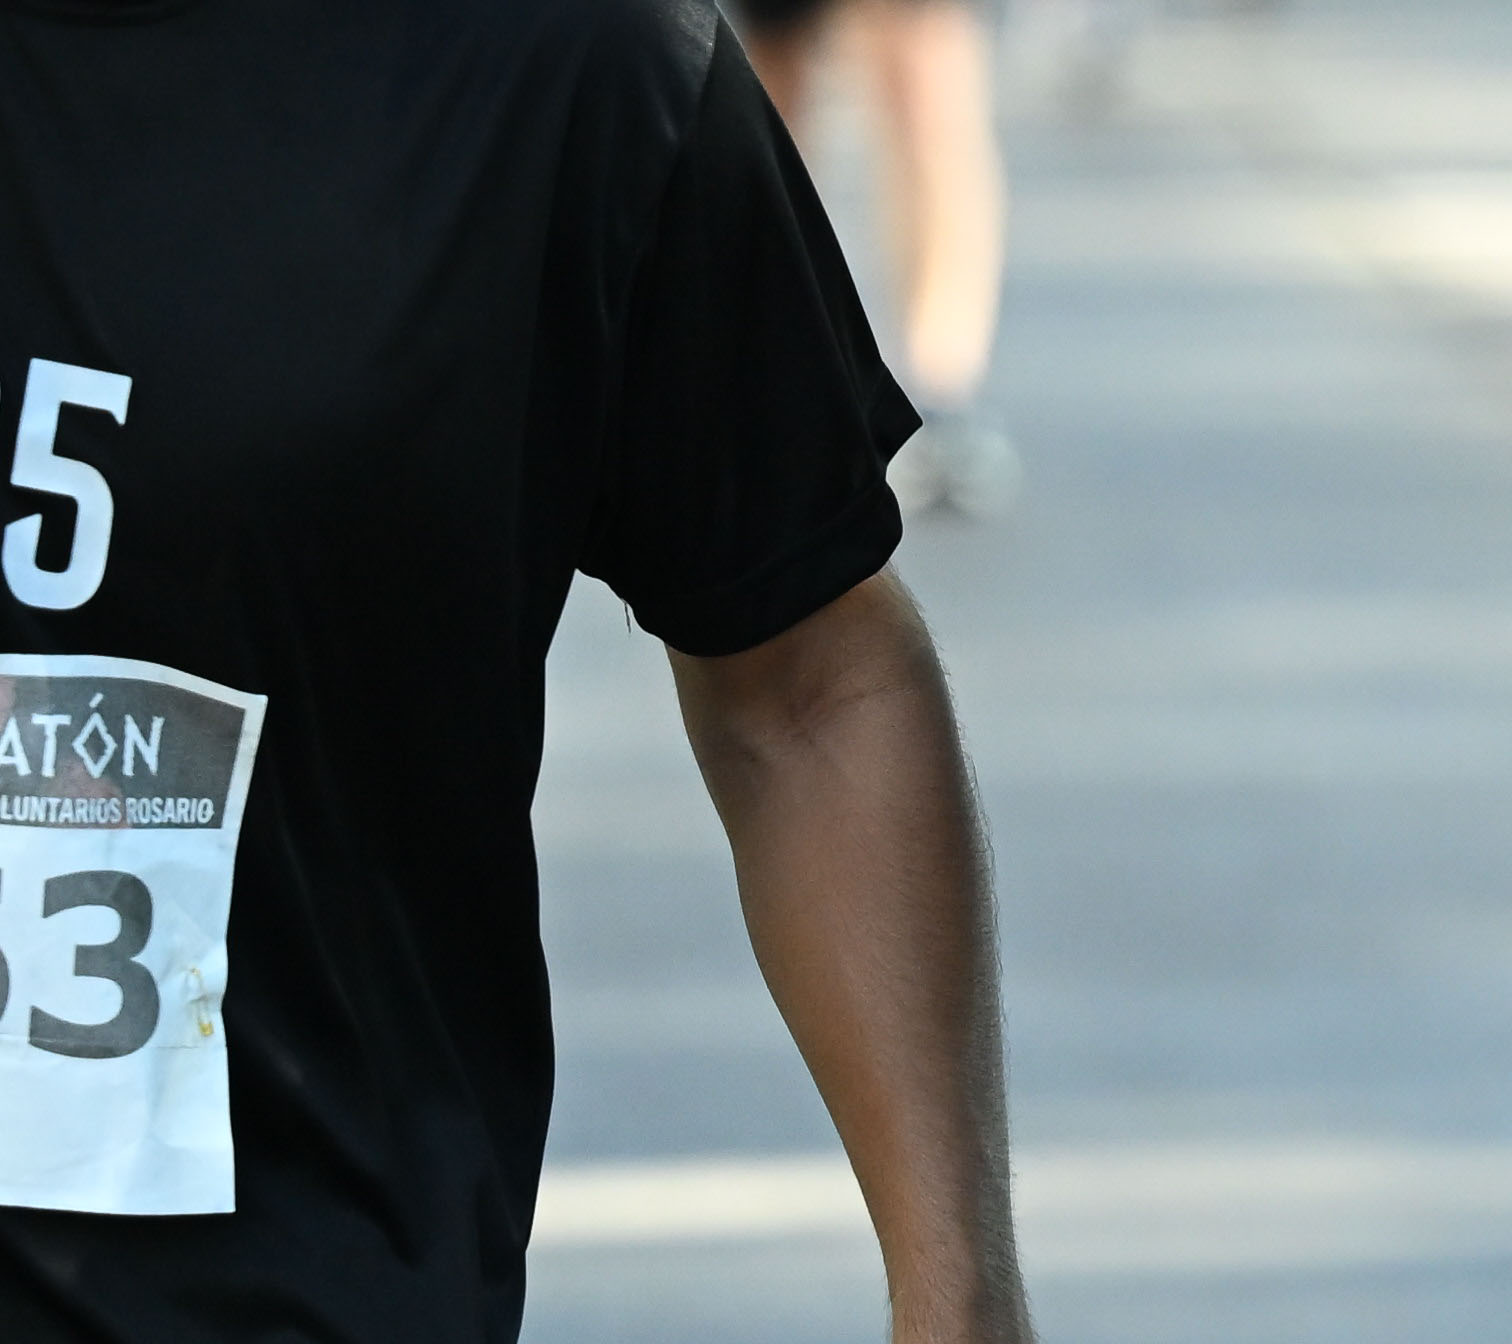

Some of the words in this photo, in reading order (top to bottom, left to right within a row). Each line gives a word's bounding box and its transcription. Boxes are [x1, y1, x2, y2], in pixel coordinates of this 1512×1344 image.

[2, 357, 132, 611] 5
[125, 796, 215, 824] ROSARIO
[0, 870, 160, 1058] 3
